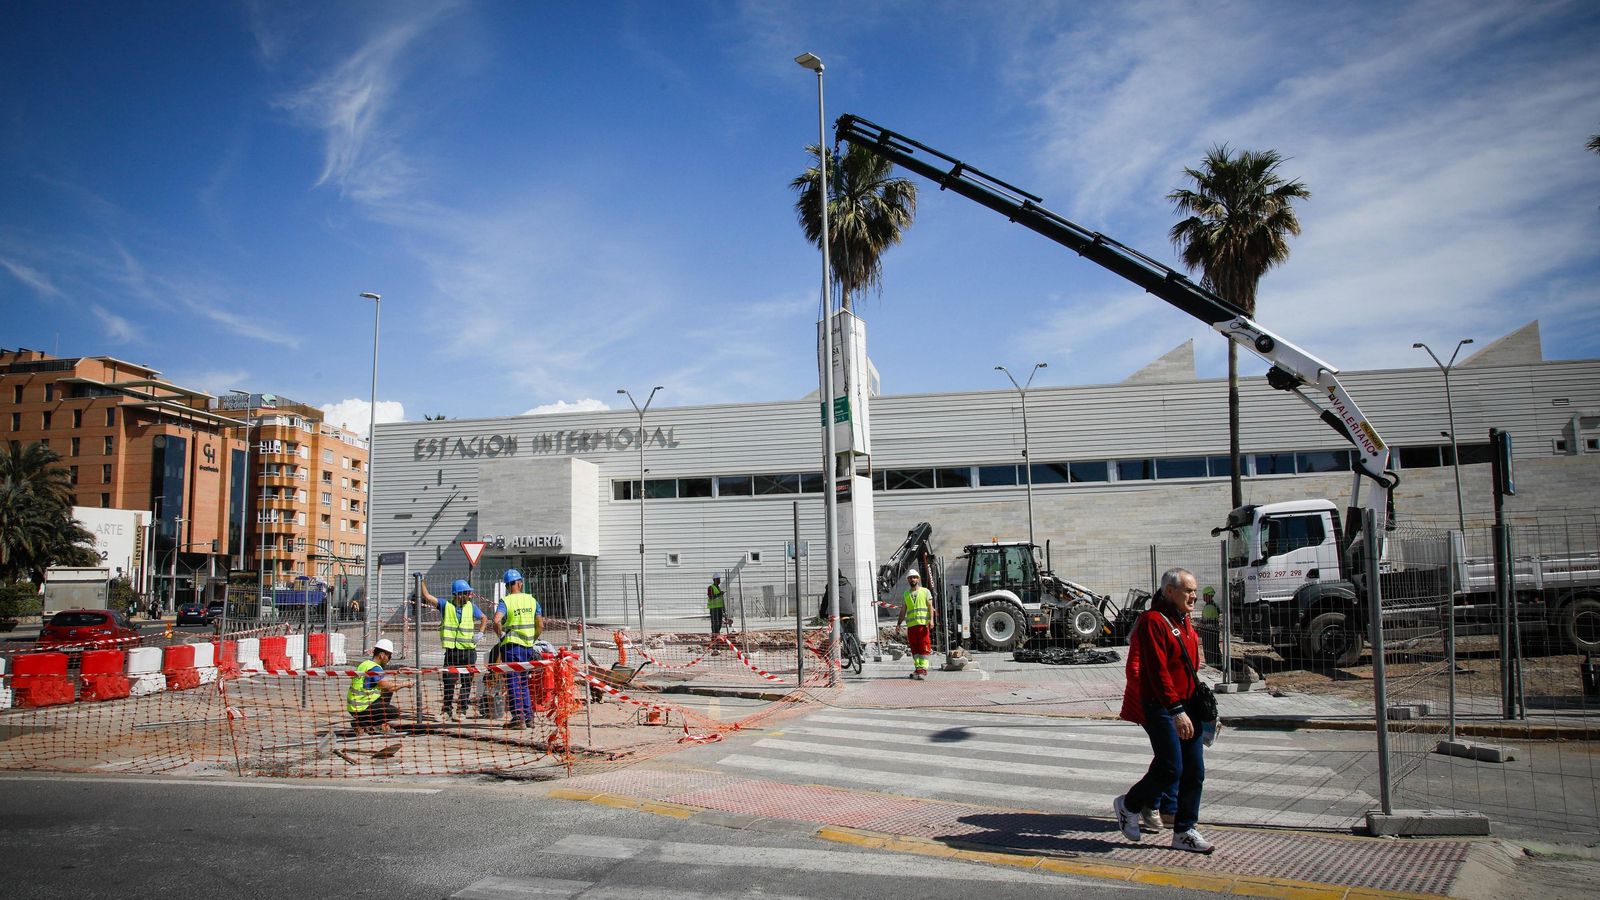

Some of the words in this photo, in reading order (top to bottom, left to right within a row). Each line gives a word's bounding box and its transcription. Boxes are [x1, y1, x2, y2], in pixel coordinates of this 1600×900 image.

[1333, 398, 1376, 454] VALERIANO
[532, 426, 681, 455] INTERMODAL
[96, 523, 123, 536] ARTE
[511, 532, 564, 548] ALMERÍA
[1259, 571, 1271, 579] 902
[1274, 570, 1287, 578] 297
[1290, 569, 1302, 577] 298
